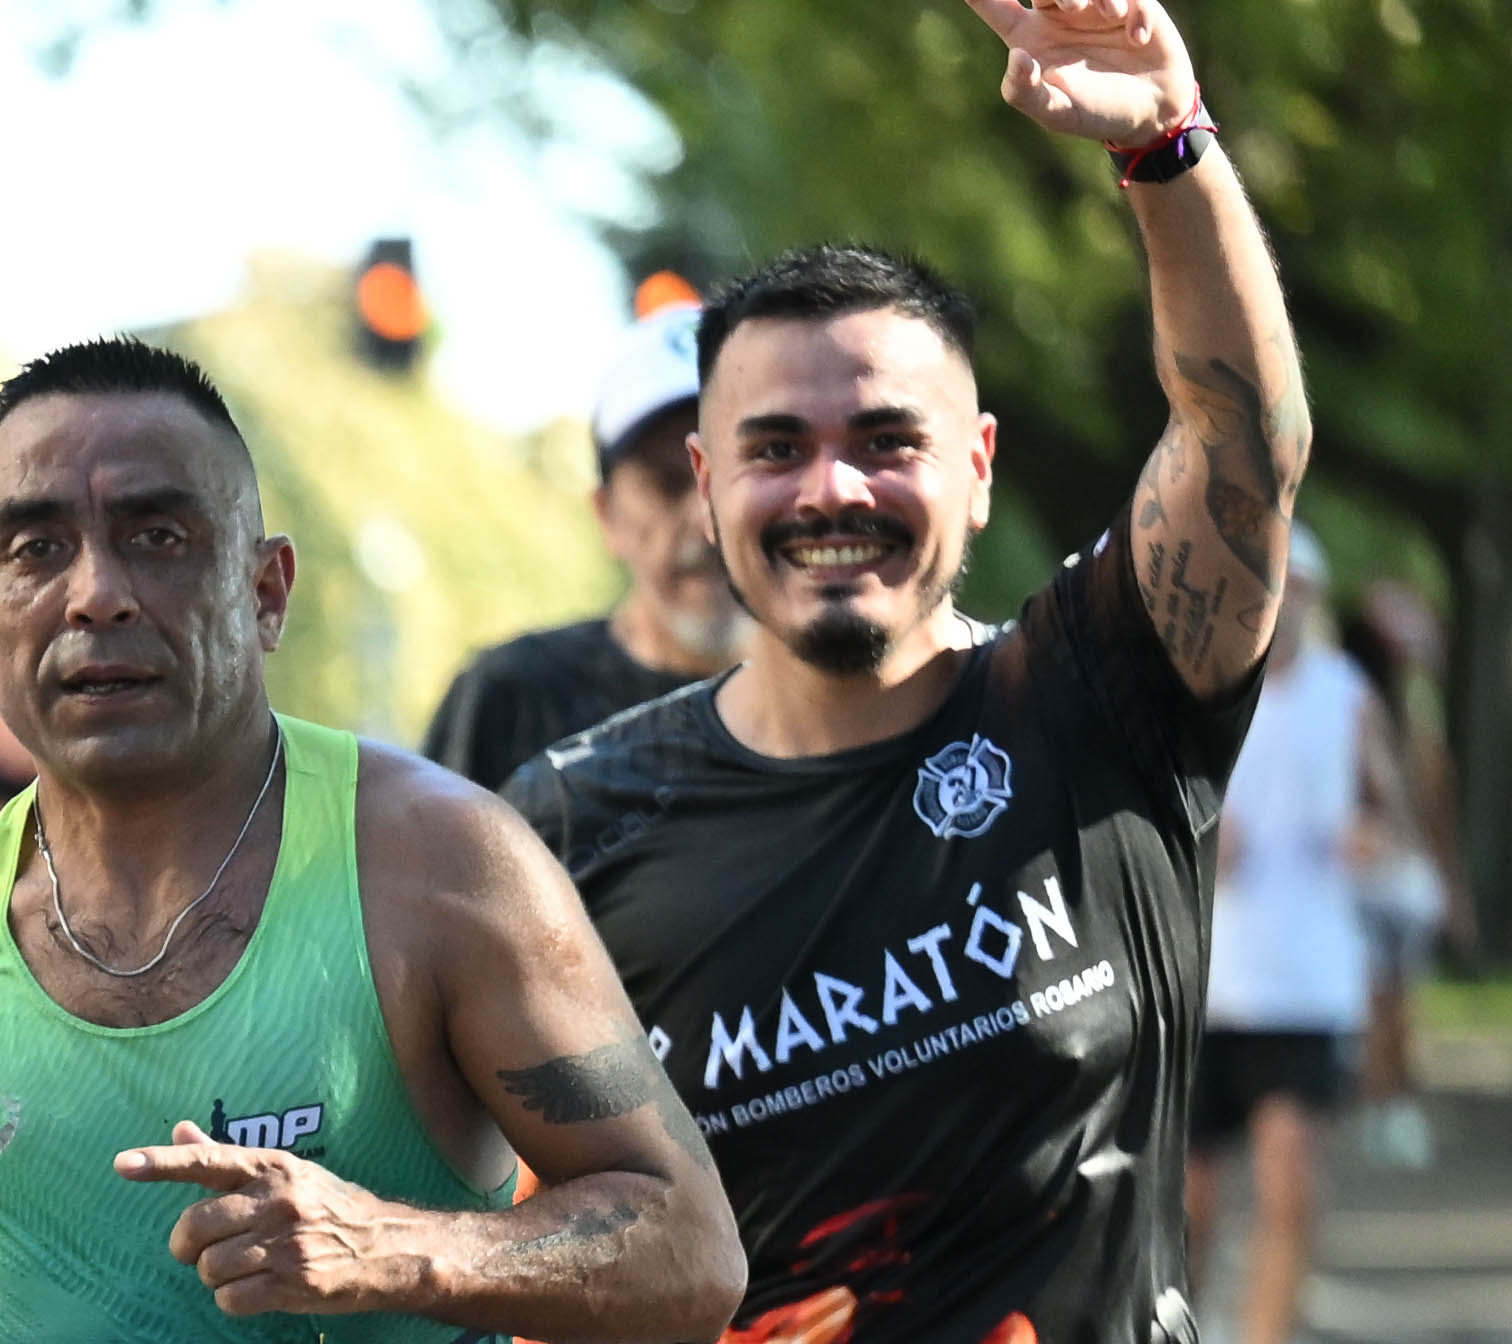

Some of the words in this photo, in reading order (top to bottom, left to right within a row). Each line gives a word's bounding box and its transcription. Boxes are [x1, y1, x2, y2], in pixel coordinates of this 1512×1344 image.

[704, 876, 1079, 1090] MARATÓN
[731, 1063, 866, 1126] BOMBEROS
[868, 1000, 1030, 1079] VOLUNTARIOS
[1030, 961, 1115, 1020] ROSARIO
